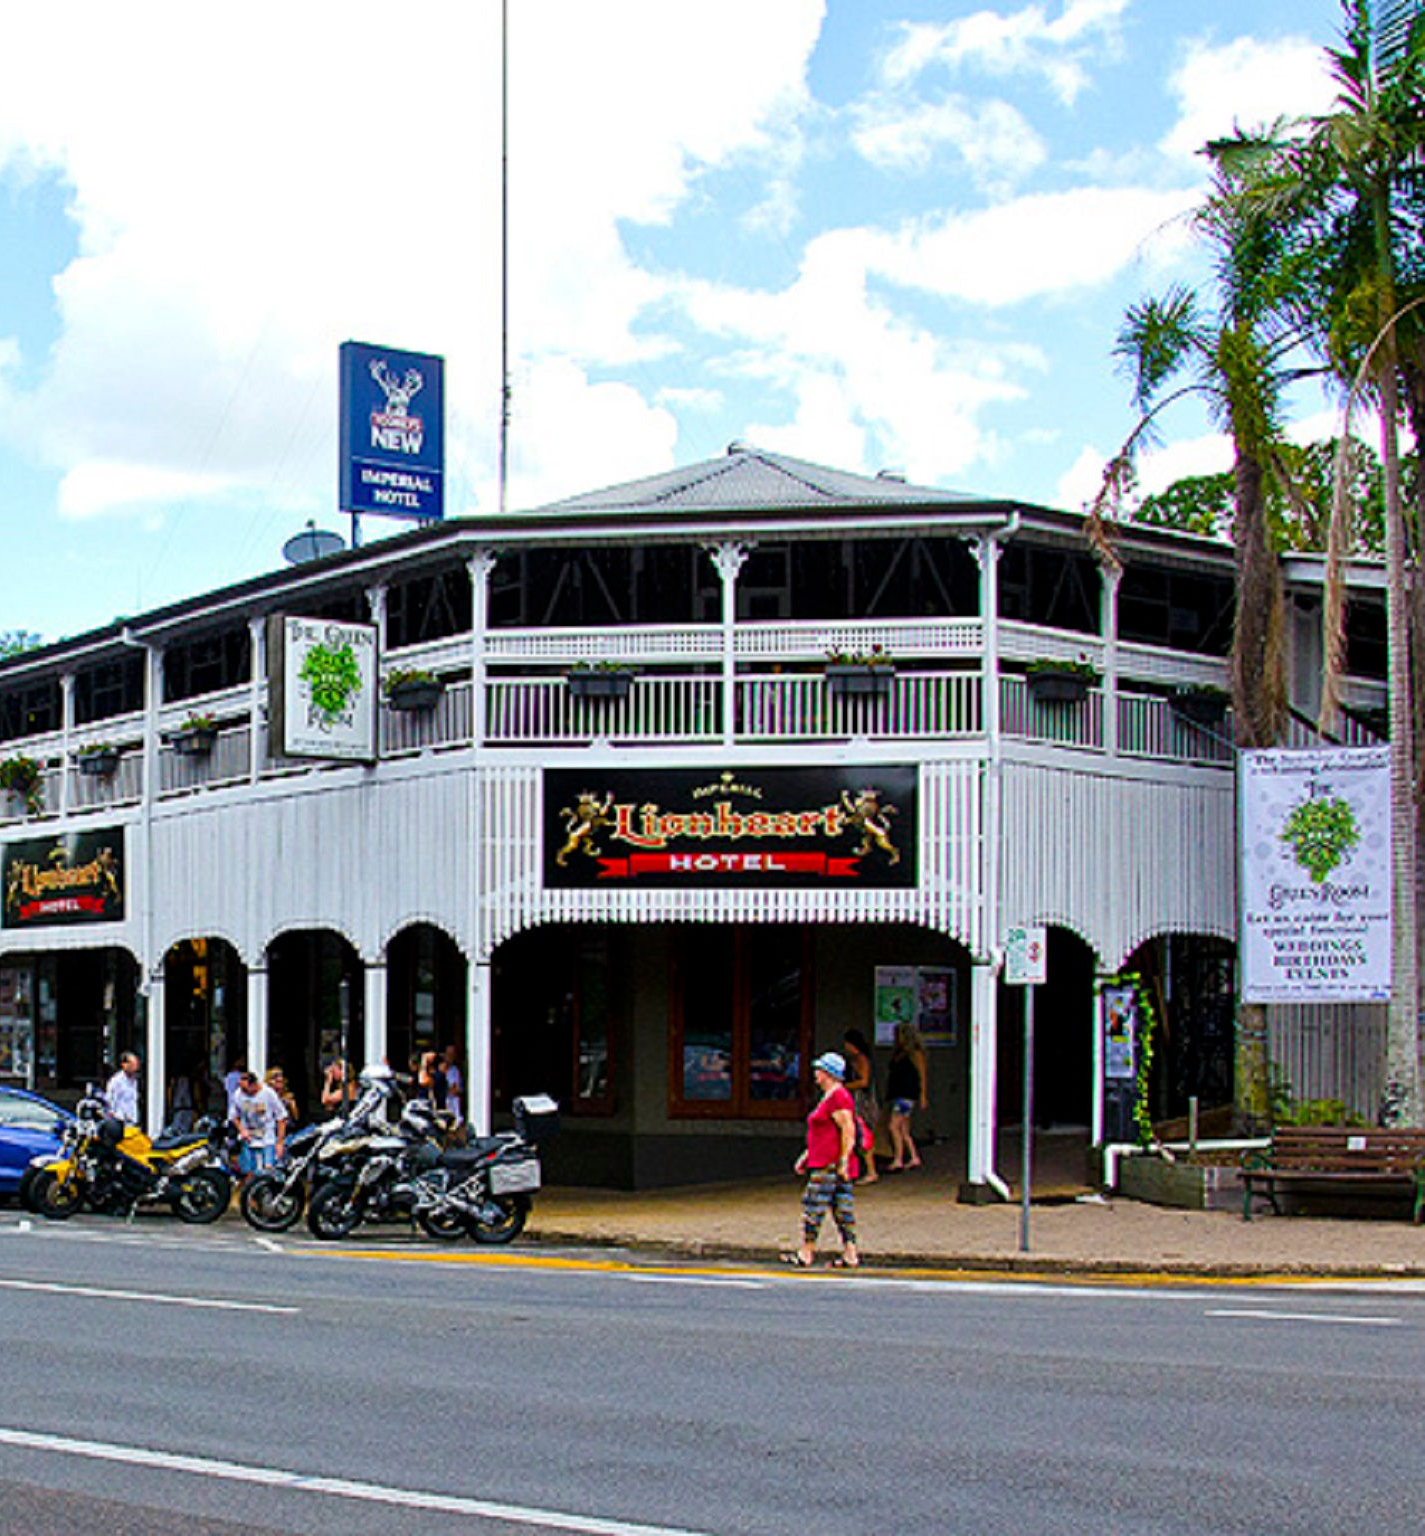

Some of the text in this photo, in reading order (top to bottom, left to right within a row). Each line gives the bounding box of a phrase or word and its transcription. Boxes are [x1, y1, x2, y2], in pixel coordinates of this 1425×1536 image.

[371, 425, 423, 455] NEW
[361, 469, 433, 492] IMPERIAL
[374, 490, 421, 508] HOTEL
[609, 801, 846, 849] Lionheart
[668, 854, 787, 871] HOTEL
[1273, 940, 1363, 952] WEDDINGS
[1272, 955, 1367, 967] BIRTHDAYS
[1283, 968, 1349, 980] EVENTS
